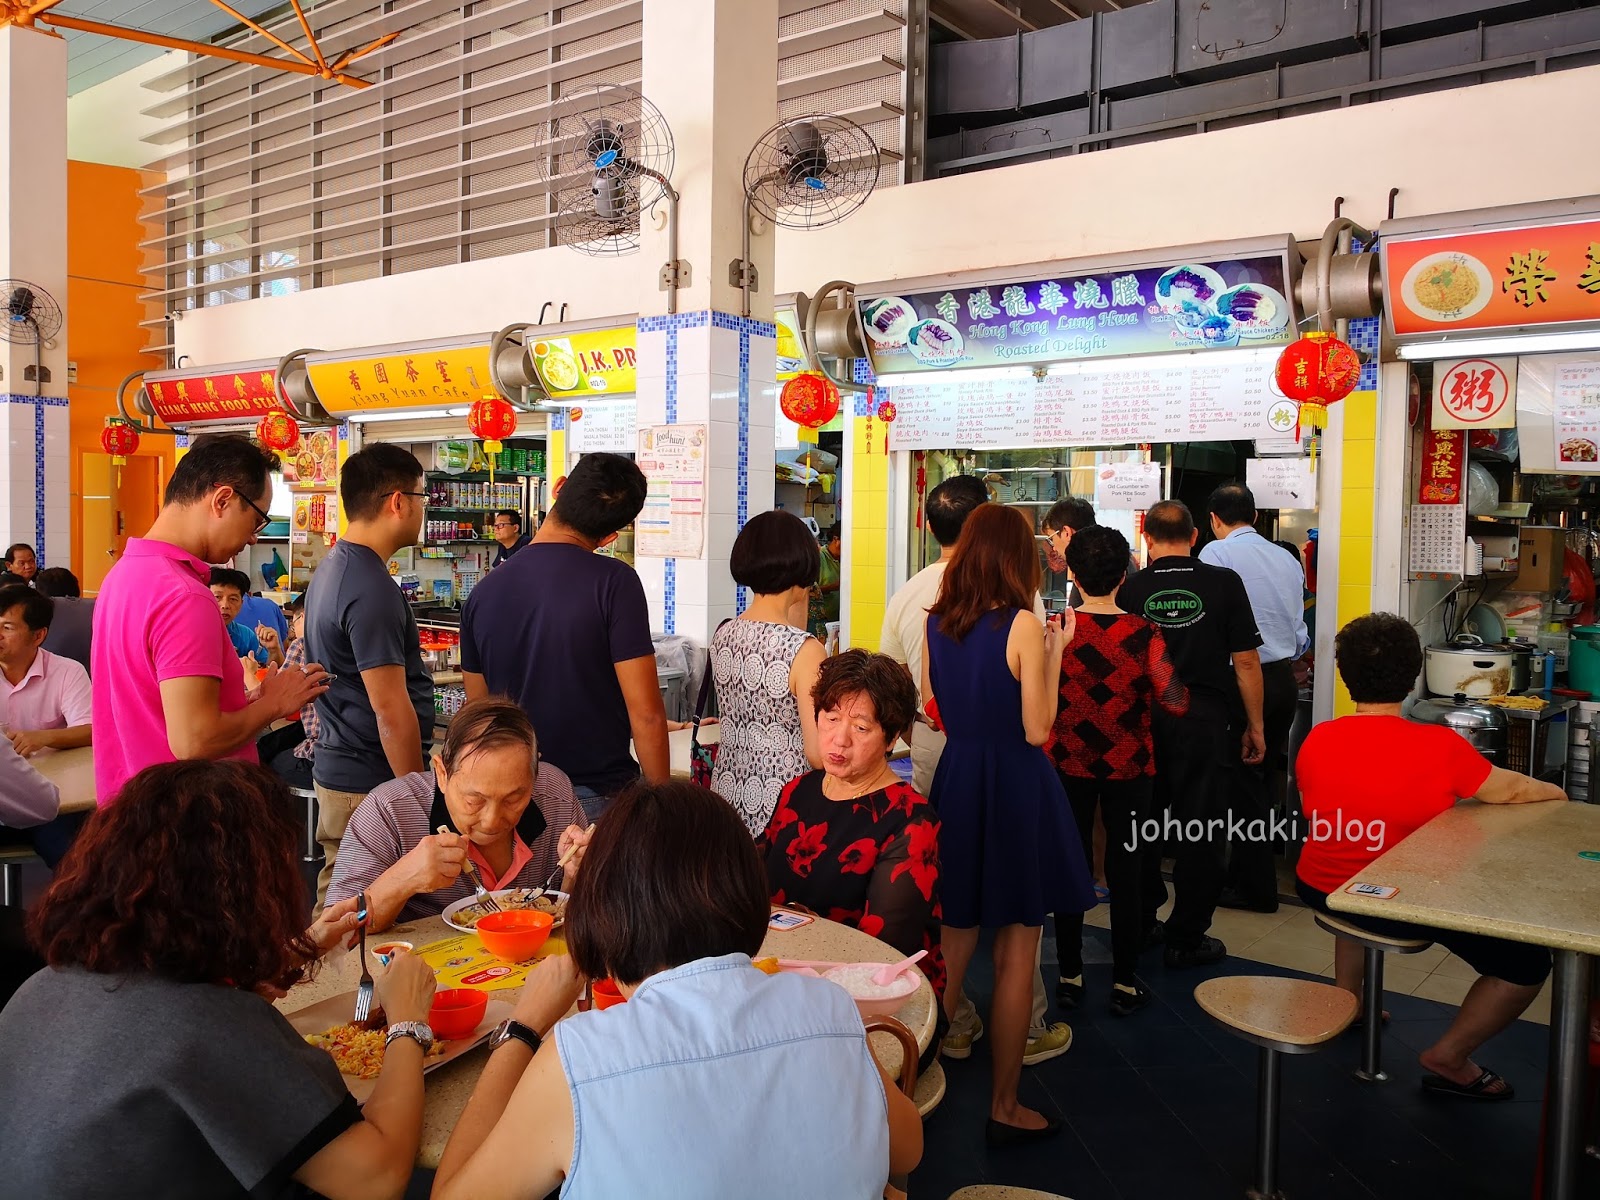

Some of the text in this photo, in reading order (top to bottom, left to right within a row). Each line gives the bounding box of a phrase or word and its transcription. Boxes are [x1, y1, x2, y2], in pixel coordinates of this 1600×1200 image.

[936, 274, 1146, 324] 香港龍華燒臘
[969, 311, 1138, 339] Hong Kong Lung Hwa
[994, 335, 1107, 358] Roasted Delight
[579, 347, 636, 374] J.K. PR
[1295, 358, 1309, 390] 吉祥
[349, 358, 452, 391] 香園茶室
[350, 385, 470, 406] Xiang Yuan Cafe
[1449, 369, 1496, 412] 粥
[159, 404, 189, 416] LIANG
[190, 401, 219, 414] HENG
[220, 399, 251, 411] FOOD
[656, 430, 685, 446] food hunt
[1149, 600, 1197, 610] SANTINO
